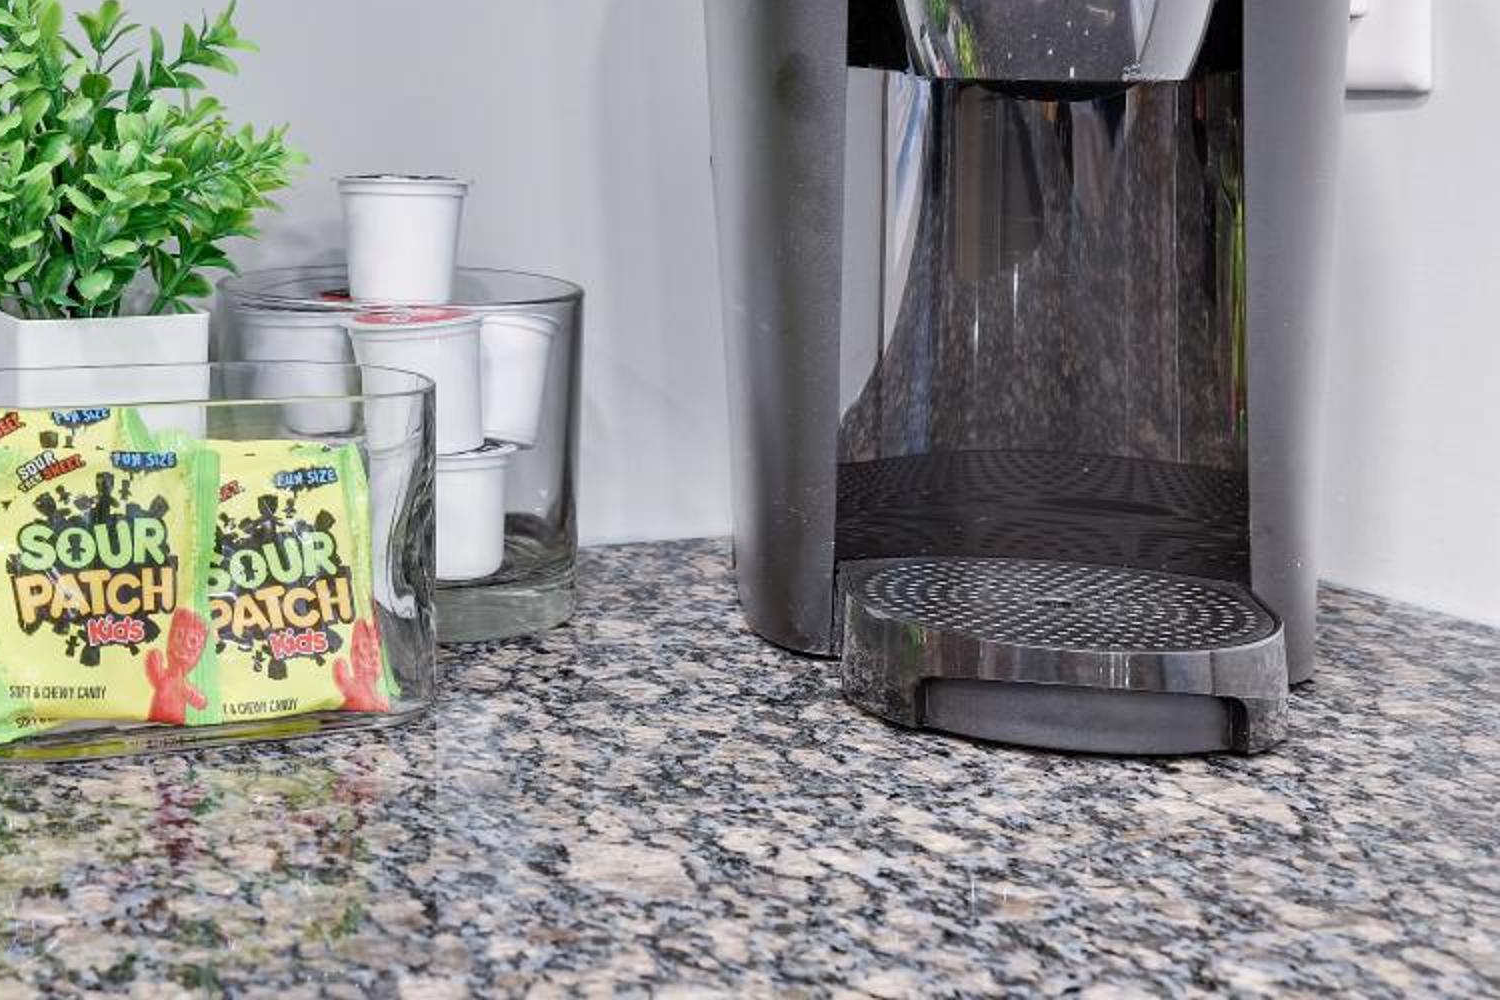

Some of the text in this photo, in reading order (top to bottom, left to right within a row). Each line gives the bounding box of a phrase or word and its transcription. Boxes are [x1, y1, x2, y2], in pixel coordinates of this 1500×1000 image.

[83, 408, 110, 421] SIZE
[18, 451, 56, 479] SOUR
[113, 453, 175, 467] FUN SIZE
[276, 469, 337, 486] FUN SIZE
[19, 517, 166, 571] SOUR
[15, 567, 175, 624] PATCH
[87, 614, 145, 647] Kids
[269, 627, 329, 660] Kids
[77, 685, 107, 699] CANDY
